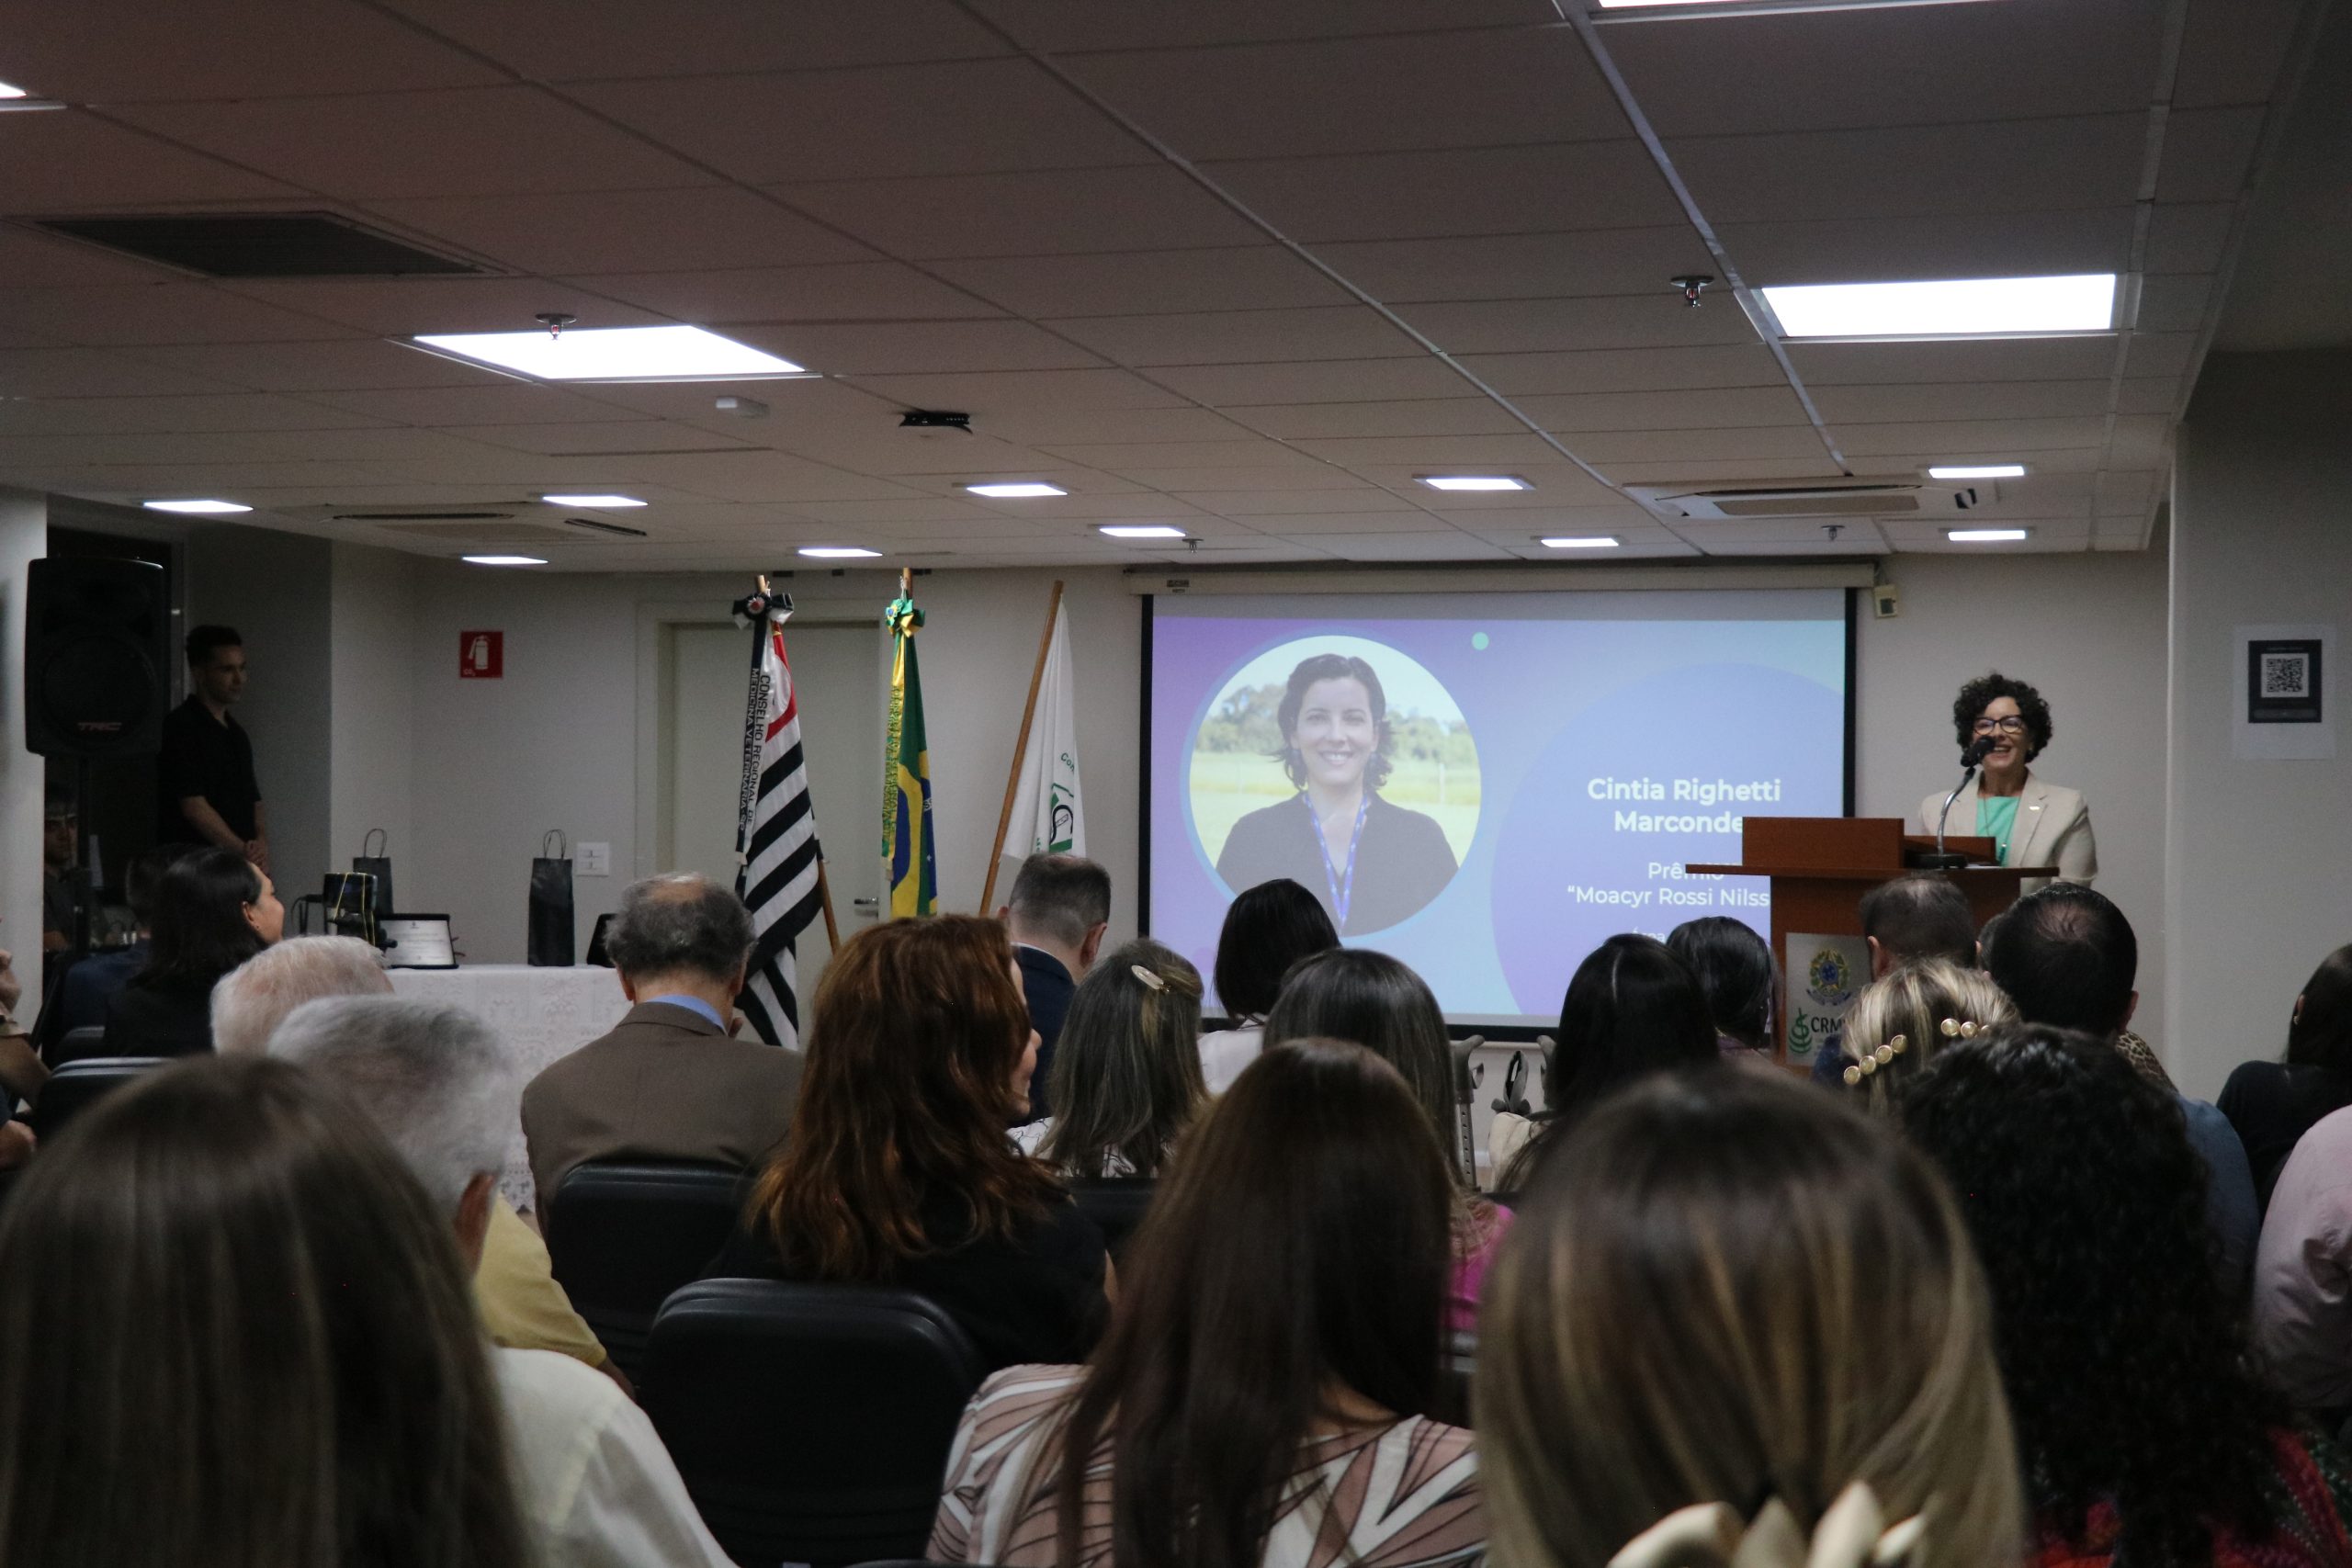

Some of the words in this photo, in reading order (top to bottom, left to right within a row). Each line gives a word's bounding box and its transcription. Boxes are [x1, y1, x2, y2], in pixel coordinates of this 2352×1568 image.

[754, 674, 771, 741] CONSELHO
[748, 745, 762, 801] REGIONAL
[1588, 777, 1665, 800] Cintia
[1674, 778, 1781, 807] Righetti
[1659, 887, 1713, 905] Rossi
[1811, 1016, 1846, 1034] CRM
